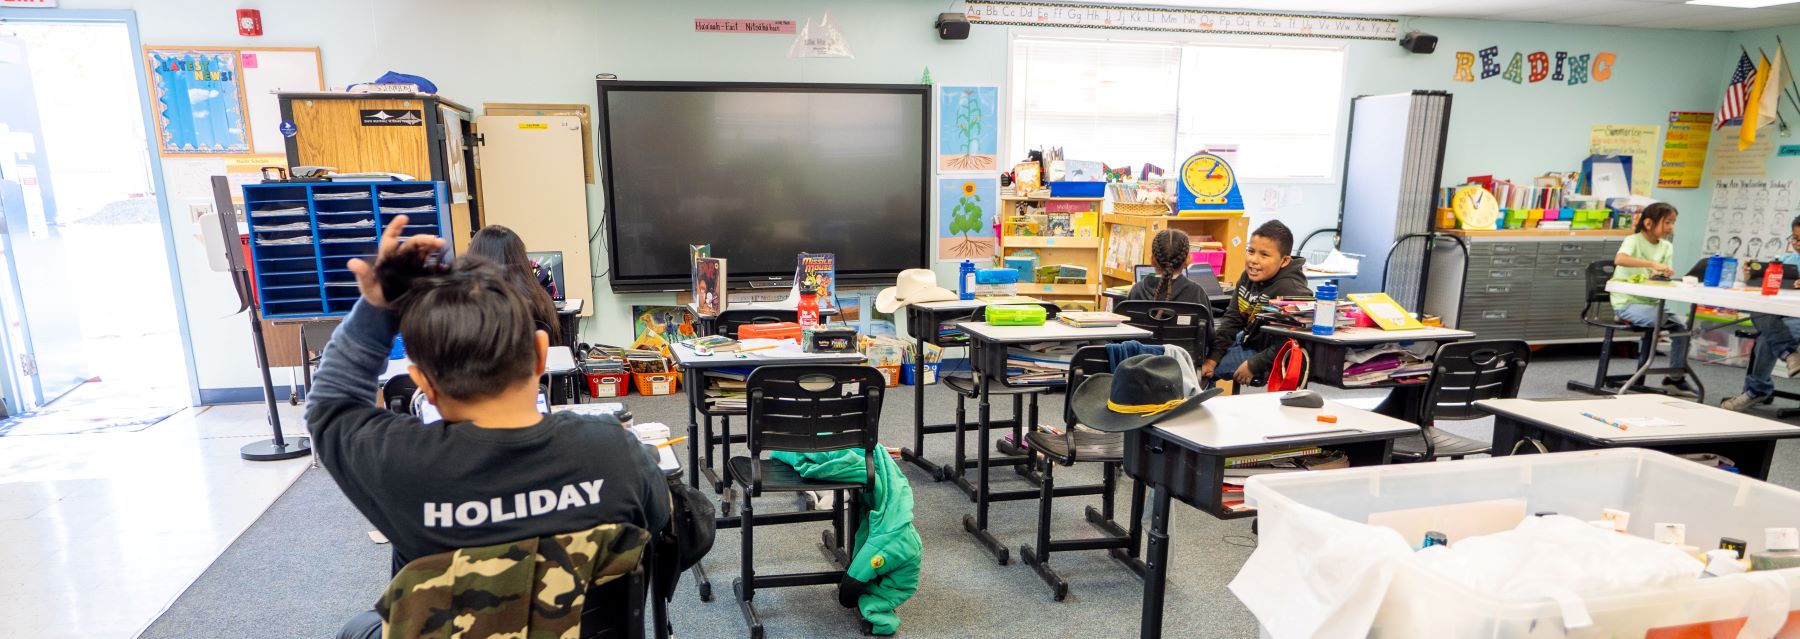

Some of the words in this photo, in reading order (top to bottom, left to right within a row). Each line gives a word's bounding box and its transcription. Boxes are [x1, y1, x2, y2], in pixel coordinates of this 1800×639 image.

[967, 5, 980, 15] Aa
[986, 6, 998, 15] Bb
[1002, 7, 1015, 16] Cc
[1020, 7, 1032, 17] Dd
[1038, 8, 1048, 17] Ee
[1054, 8, 1063, 18] Ff
[1068, 9, 1081, 23] Gg
[1087, 10, 1099, 20] Hh
[1115, 11, 1125, 25] Jj
[1130, 11, 1141, 22] Kk
[1147, 12, 1155, 22] Ll
[1161, 13, 1177, 23] Mm
[1183, 14, 1195, 24] Nn
[1200, 15, 1214, 25] Oo
[1220, 16, 1230, 29] Pp
[1236, 16, 1250, 30] Qq
[1257, 17, 1265, 27] Rr
[1273, 17, 1280, 27] Ss
[1319, 20, 1329, 30] Vv
[1335, 20, 1350, 30] Ww
[1356, 21, 1365, 31] Xx
[1371, 22, 1380, 34] Yy
[1386, 23, 1395, 33] Zz
[162, 60, 209, 72] LATEST
[194, 71, 233, 82] NEWS!
[1453, 46, 1616, 86] READING
[424, 479, 604, 527] HOLIDAY
